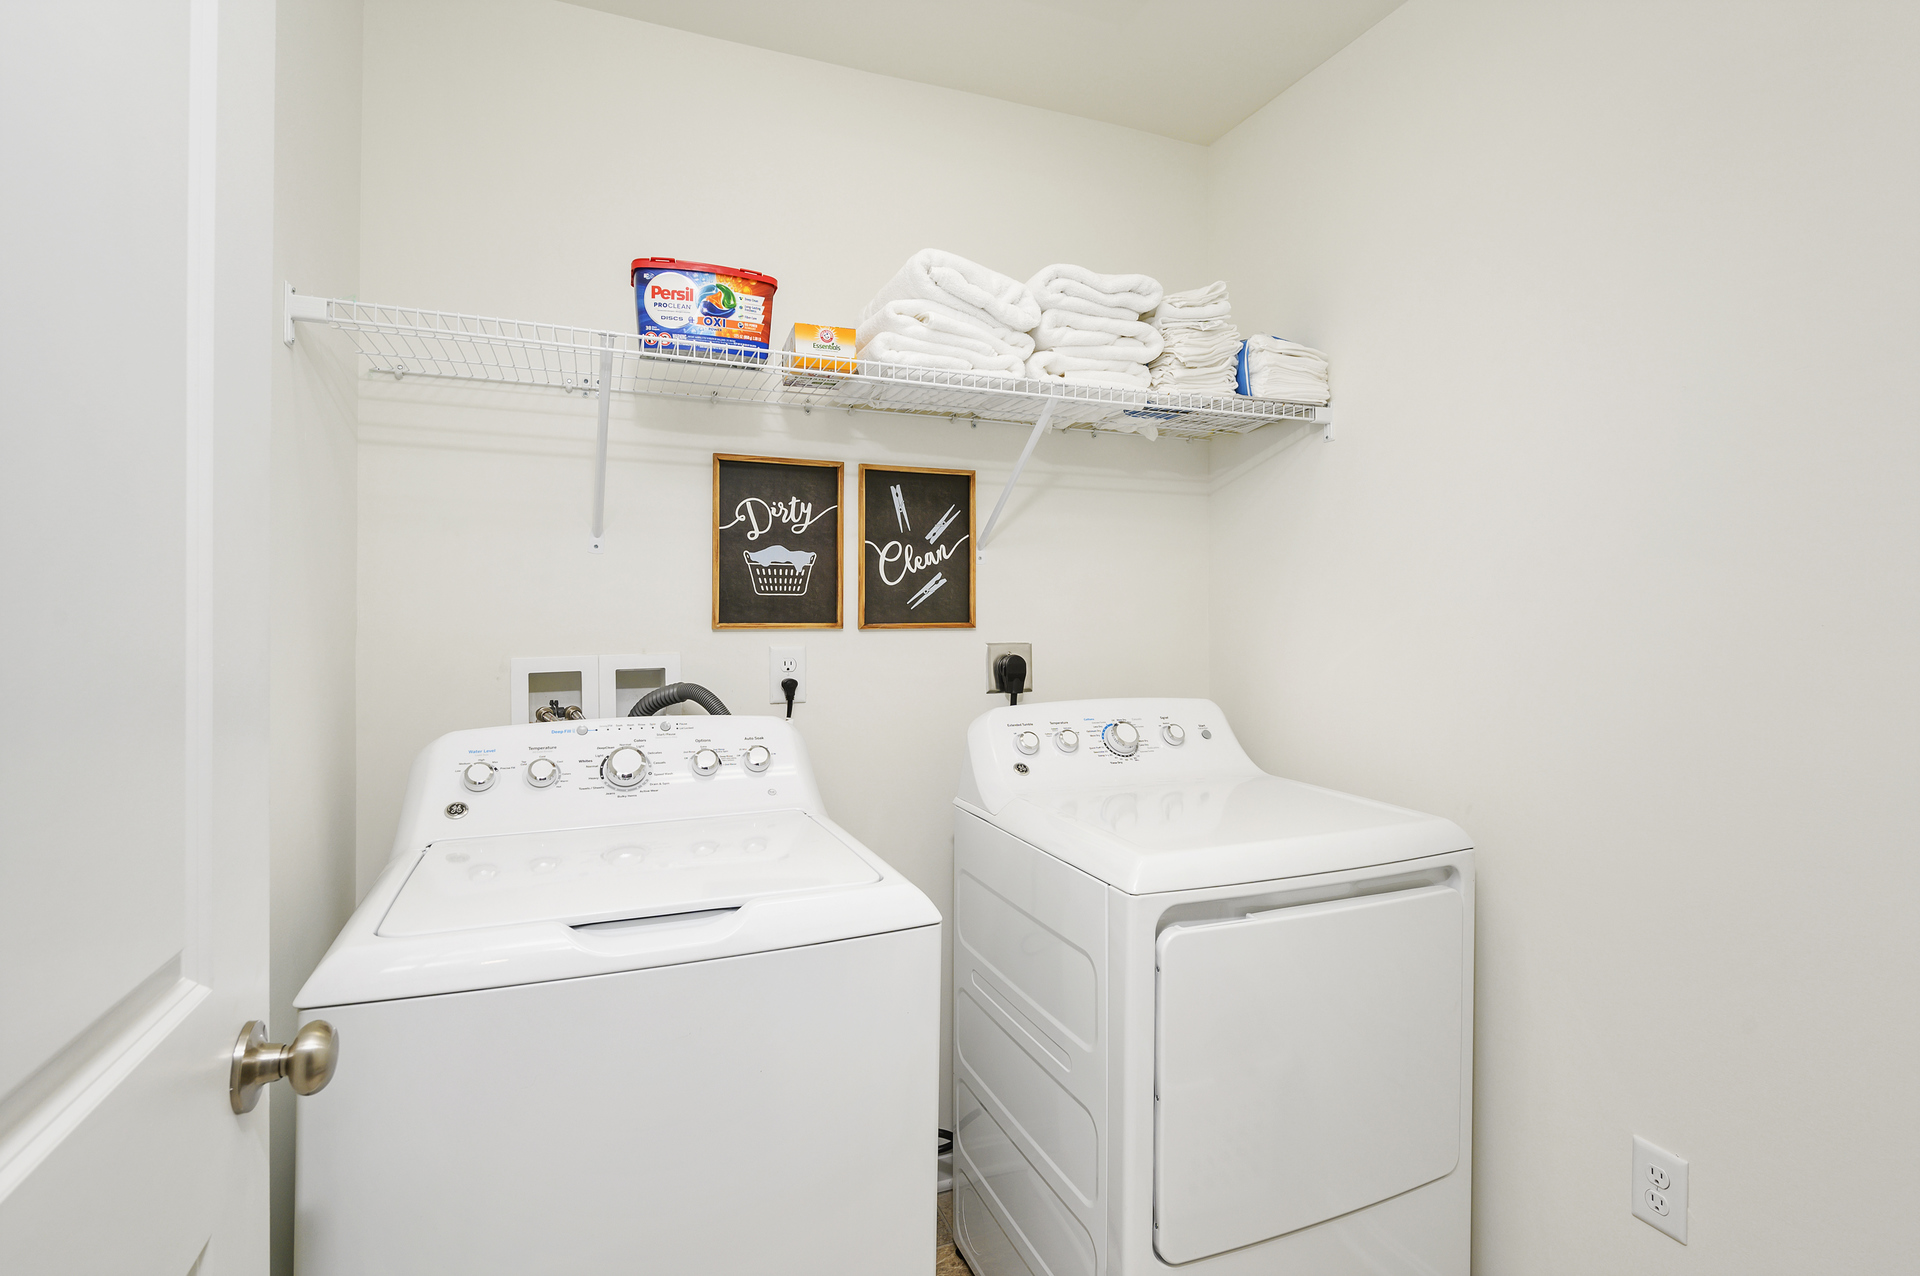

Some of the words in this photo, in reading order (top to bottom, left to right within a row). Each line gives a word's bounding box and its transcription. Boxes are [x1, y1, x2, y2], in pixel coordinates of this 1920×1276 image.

[651, 285, 694, 302] Persil
[653, 302, 692, 310] PROCLEAN
[703, 316, 727, 328] OXI
[812, 342, 841, 351] Essentials
[730, 496, 820, 541] Dirty
[876, 538, 957, 586] Clean
